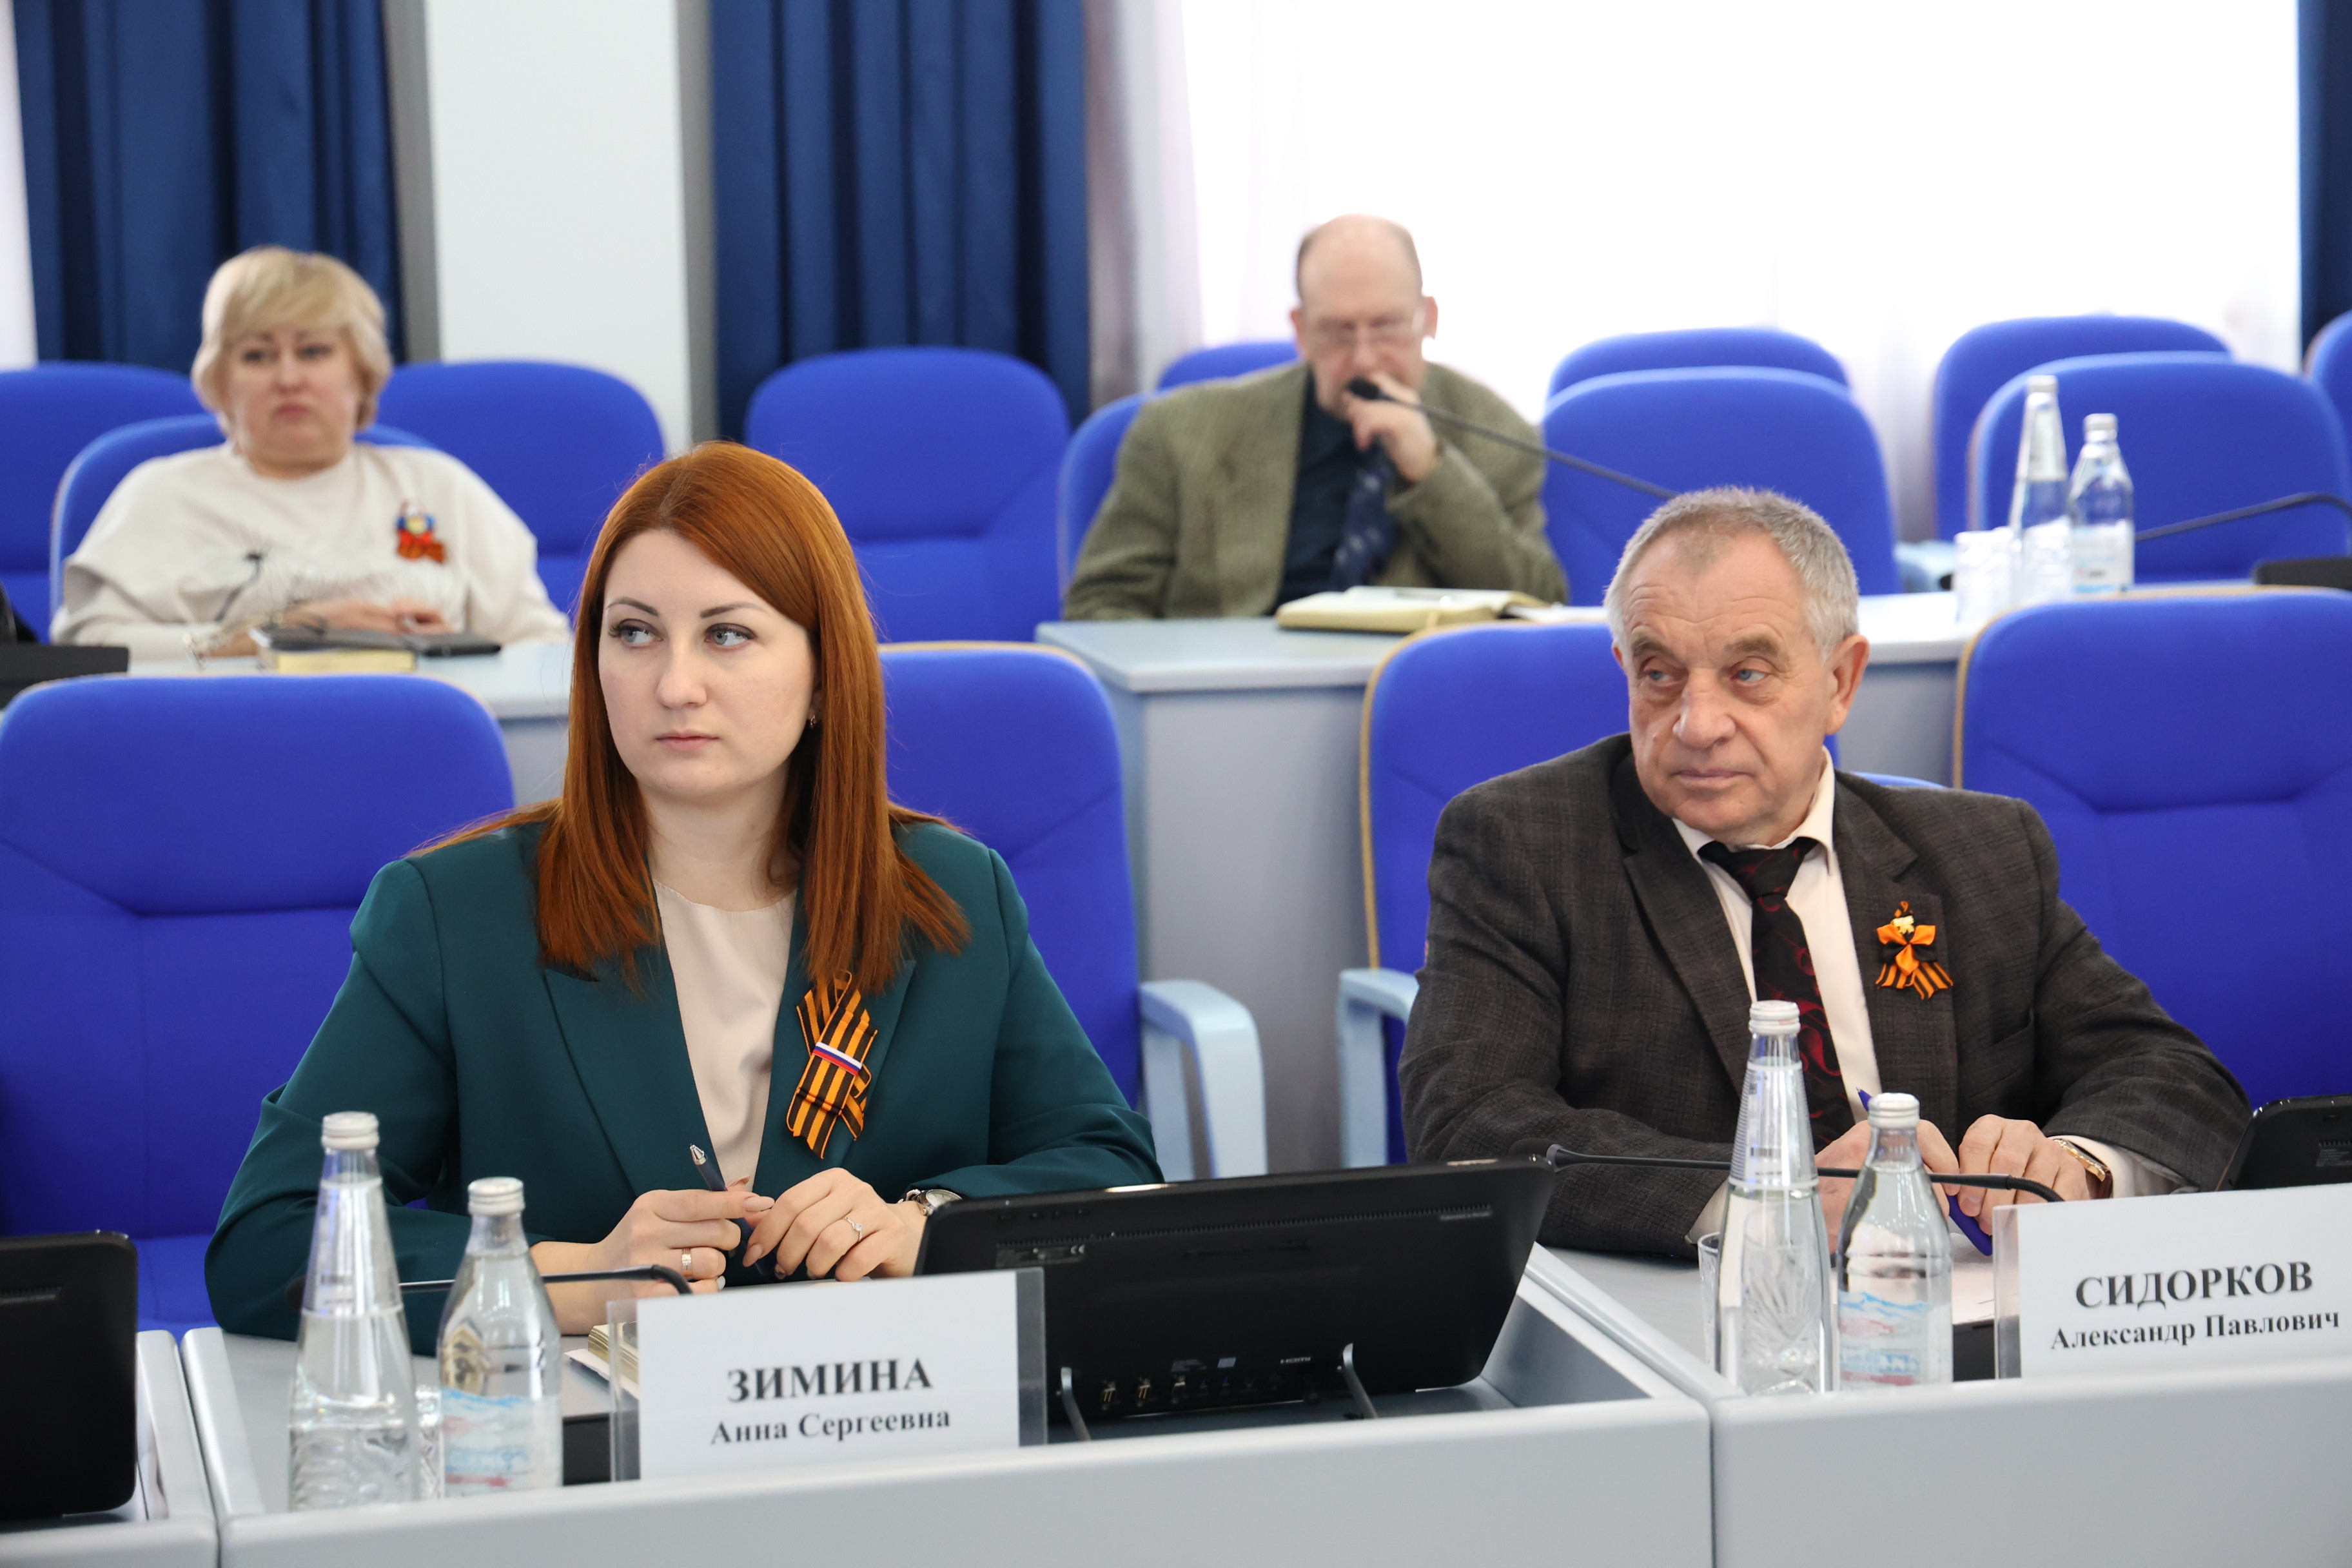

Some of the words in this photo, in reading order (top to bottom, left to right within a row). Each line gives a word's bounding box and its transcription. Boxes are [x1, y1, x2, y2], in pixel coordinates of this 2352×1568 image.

[2075, 1260, 2313, 1309] СИДОРКОВ
[2051, 1323, 2196, 1349] Александр
[2205, 1311, 2340, 1338] Павлович
[728, 1358, 933, 1403] ЗИМИНА
[710, 1421, 788, 1446] Анна
[799, 1409, 950, 1444] Сергеевна
